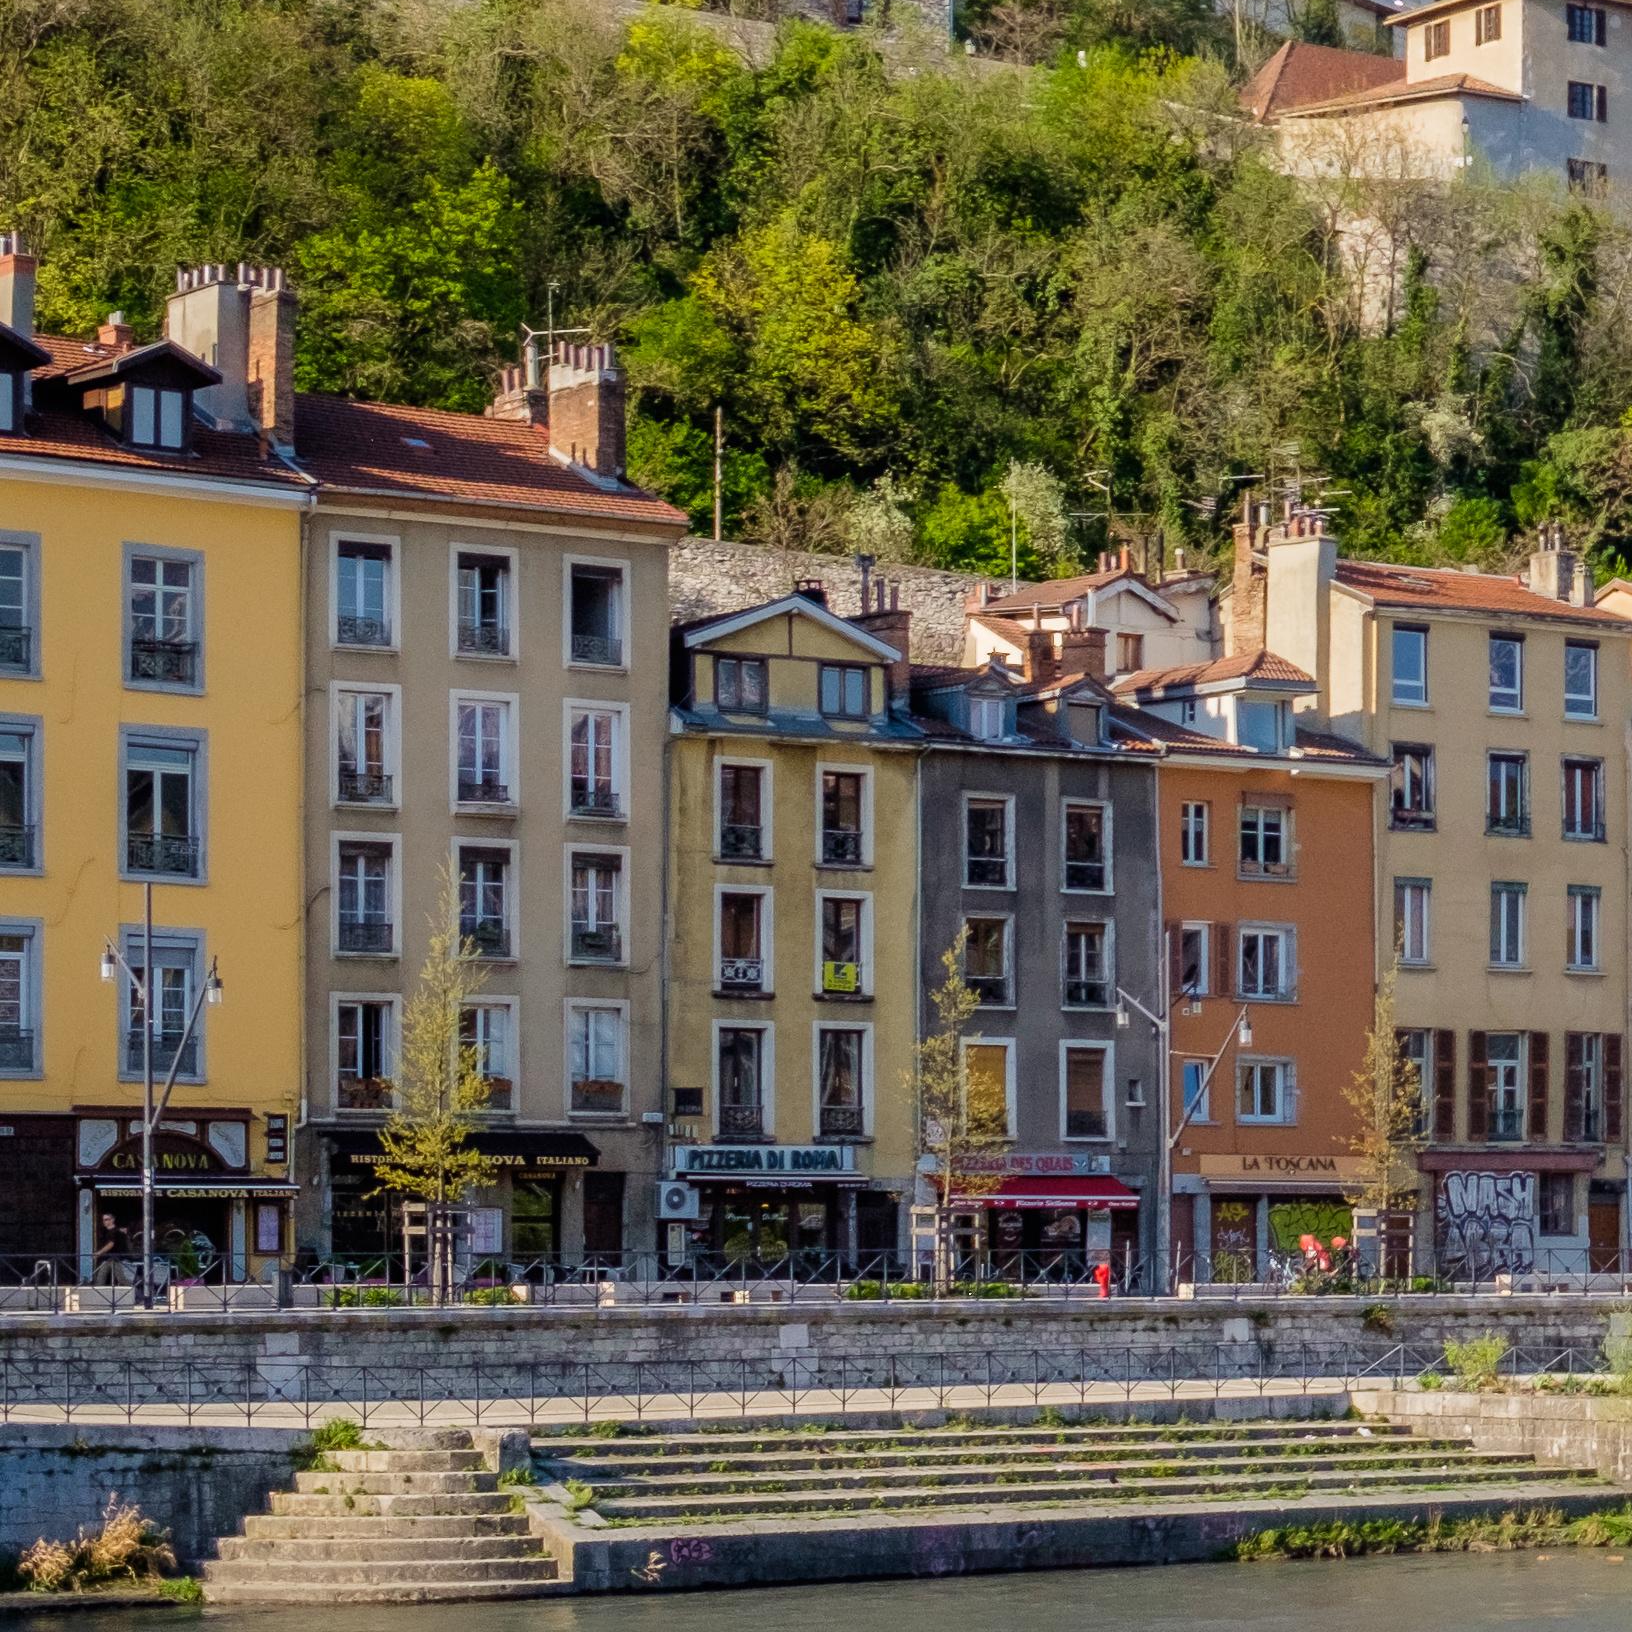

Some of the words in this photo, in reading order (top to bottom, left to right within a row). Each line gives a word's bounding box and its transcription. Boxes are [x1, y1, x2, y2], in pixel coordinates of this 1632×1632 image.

[112, 1153, 209, 1169] CAANOVA
[351, 1155, 422, 1165] RISTORA
[536, 1156, 589, 1165] ITALIANO
[688, 1150, 763, 1168] PIZZERIA
[767, 1150, 784, 1168] DI
[791, 1150, 839, 1168] ROMA
[1010, 1156, 1032, 1170] DES
[1036, 1156, 1073, 1171] QUAIS
[1242, 1157, 1260, 1170] LA
[1264, 1157, 1336, 1171] TOSCANA
[100, 1189, 163, 1198] RISTORAE
[167, 1189, 249, 1198] CASANOVA
